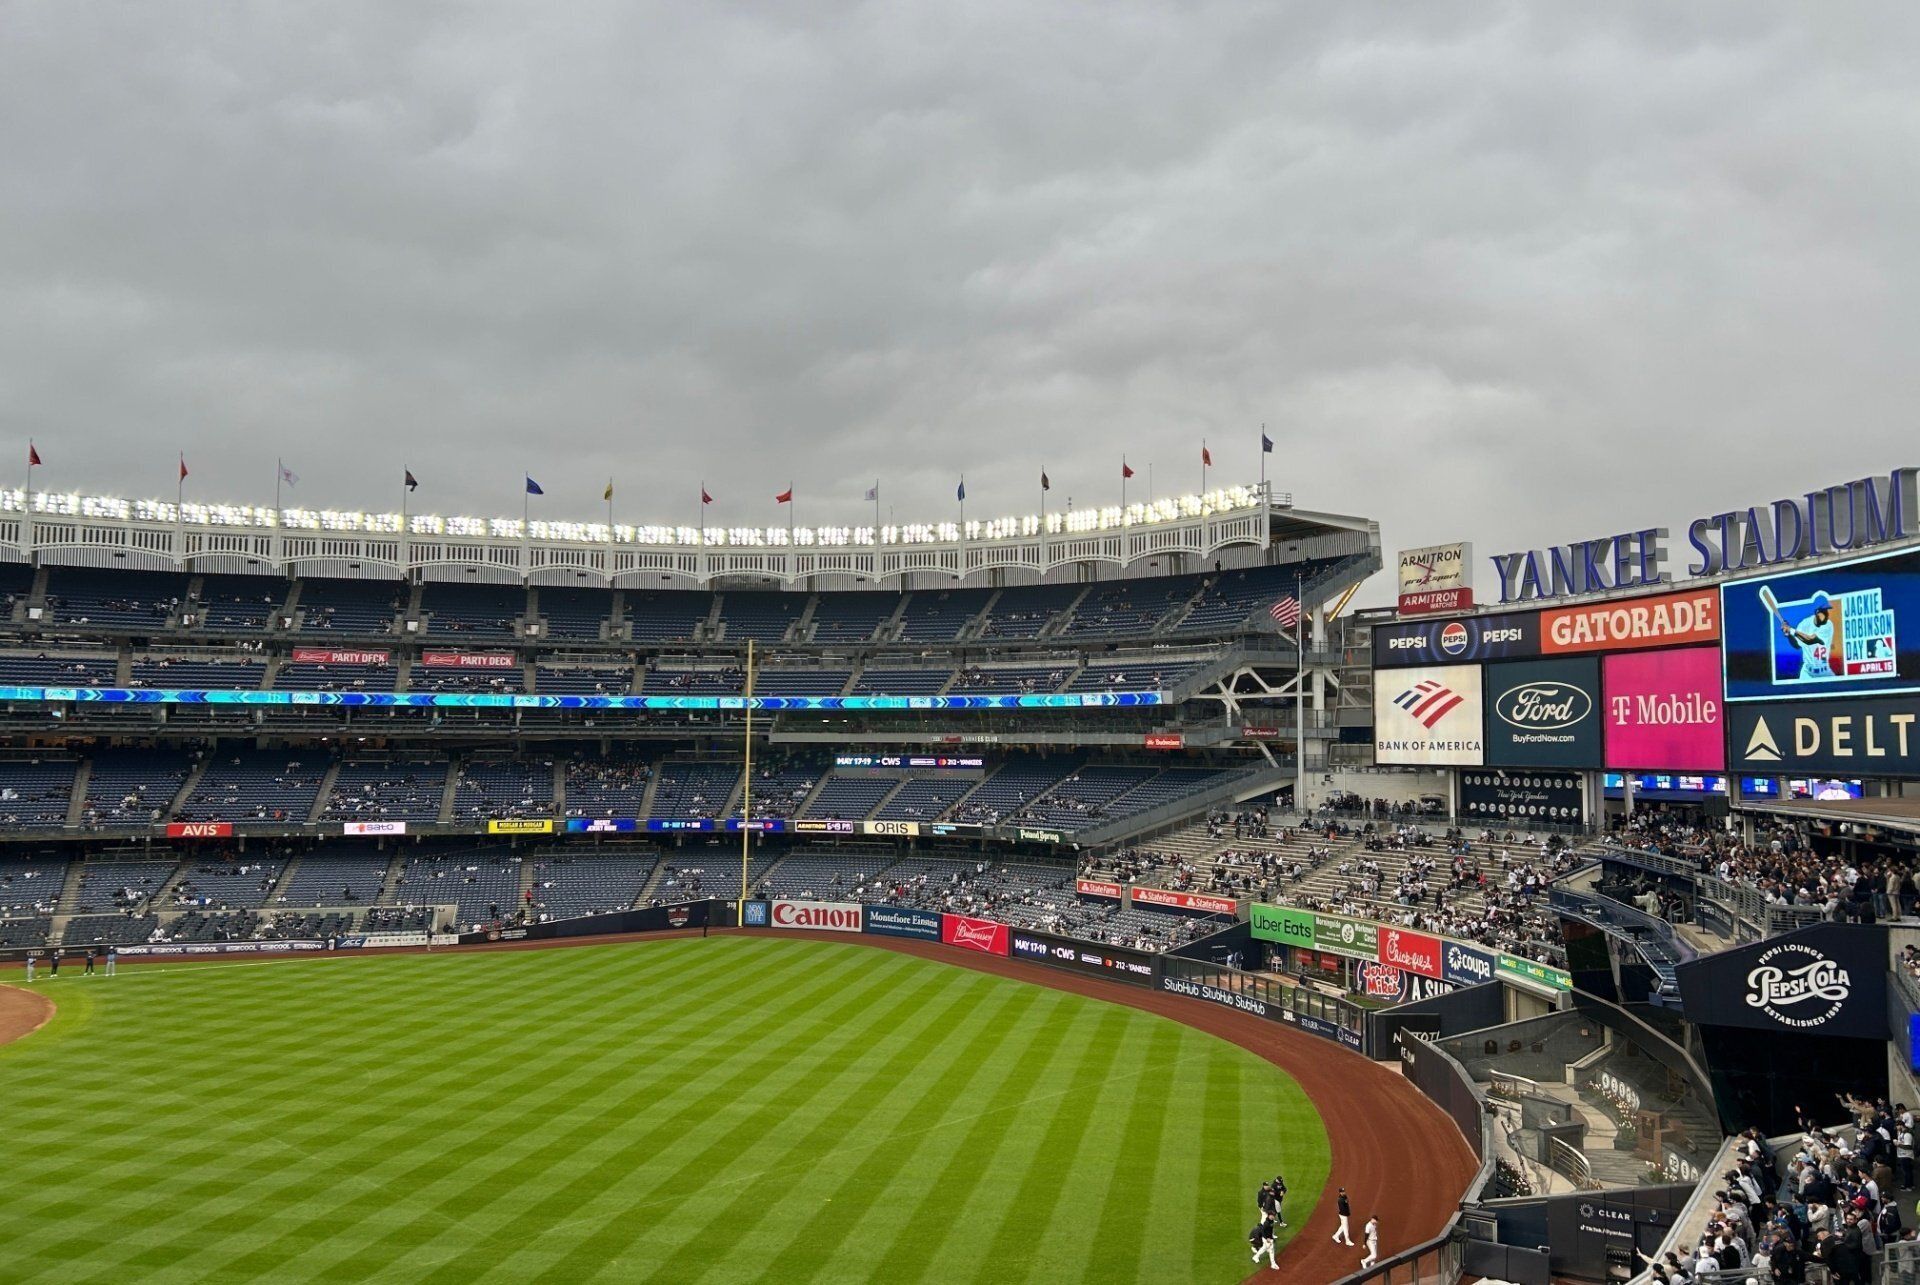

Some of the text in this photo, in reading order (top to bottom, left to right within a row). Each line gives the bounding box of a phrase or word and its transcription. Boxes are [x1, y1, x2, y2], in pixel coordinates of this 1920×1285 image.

[1489, 467, 1920, 603] YANKEE STADIUM
[1401, 549, 1462, 568] ARMITRON
[1404, 591, 1459, 606] ARMITRON
[1430, 600, 1458, 609] WATCHES
[1844, 592, 1880, 618] JACKIE
[1550, 596, 1714, 646] GATORADE
[1845, 613, 1893, 639] ROBINSON
[1389, 636, 1427, 649] PEPSI
[1443, 634, 1466, 643] PEPSI
[1483, 628, 1522, 643] PEPSI
[1813, 647, 1827, 660] 42
[1846, 640, 1864, 661] DAY
[332, 653, 386, 664] PARTY DECK
[460, 655, 513, 667] PARTY DECK
[1860, 661, 1894, 673] APRIL 15
[1511, 688, 1574, 721] Ford
[1637, 692, 1716, 725] Mobile
[1512, 734, 1575, 743] BuyFordNow.com
[1378, 741, 1481, 751] BANK OF AMERICA
[836, 757, 854, 765] MAY
[881, 757, 901, 766] CWS
[1496, 789, 1509, 799] New
[1509, 790, 1524, 803] York
[182, 825, 218, 836] AVIS
[874, 822, 909, 834] ORIS
[1020, 830, 1060, 842] Poland Spring
[746, 909, 764, 917] YORK
[773, 903, 861, 928] Canon
[870, 911, 938, 928] Montefiore Einstein
[956, 923, 993, 942] Budweiser
[1253, 914, 1282, 932] Uber
[1284, 920, 1312, 938] Eats
[343, 940, 362, 948] ACC
[1014, 939, 1030, 951] MAY
[1030, 942, 1047, 955] 17-19
[1056, 947, 1075, 961] CWS
[1758, 944, 1824, 965] PEPSI LOUNGE
[1462, 955, 1491, 979] coupa
[1500, 956, 1517, 969] bet365
[1363, 961, 1400, 983] Jersey
[1527, 965, 1545, 978] bet365
[1412, 976, 1421, 1001] A
[1164, 978, 1266, 1016] StubHub StubHub StubHub
[1763, 1005, 1826, 1027] ESTABLISHED
[1301, 1018, 1319, 1030] STARR
[1344, 1033, 1360, 1046] CLEAR
[1599, 1209, 1631, 1221] CLEAR
